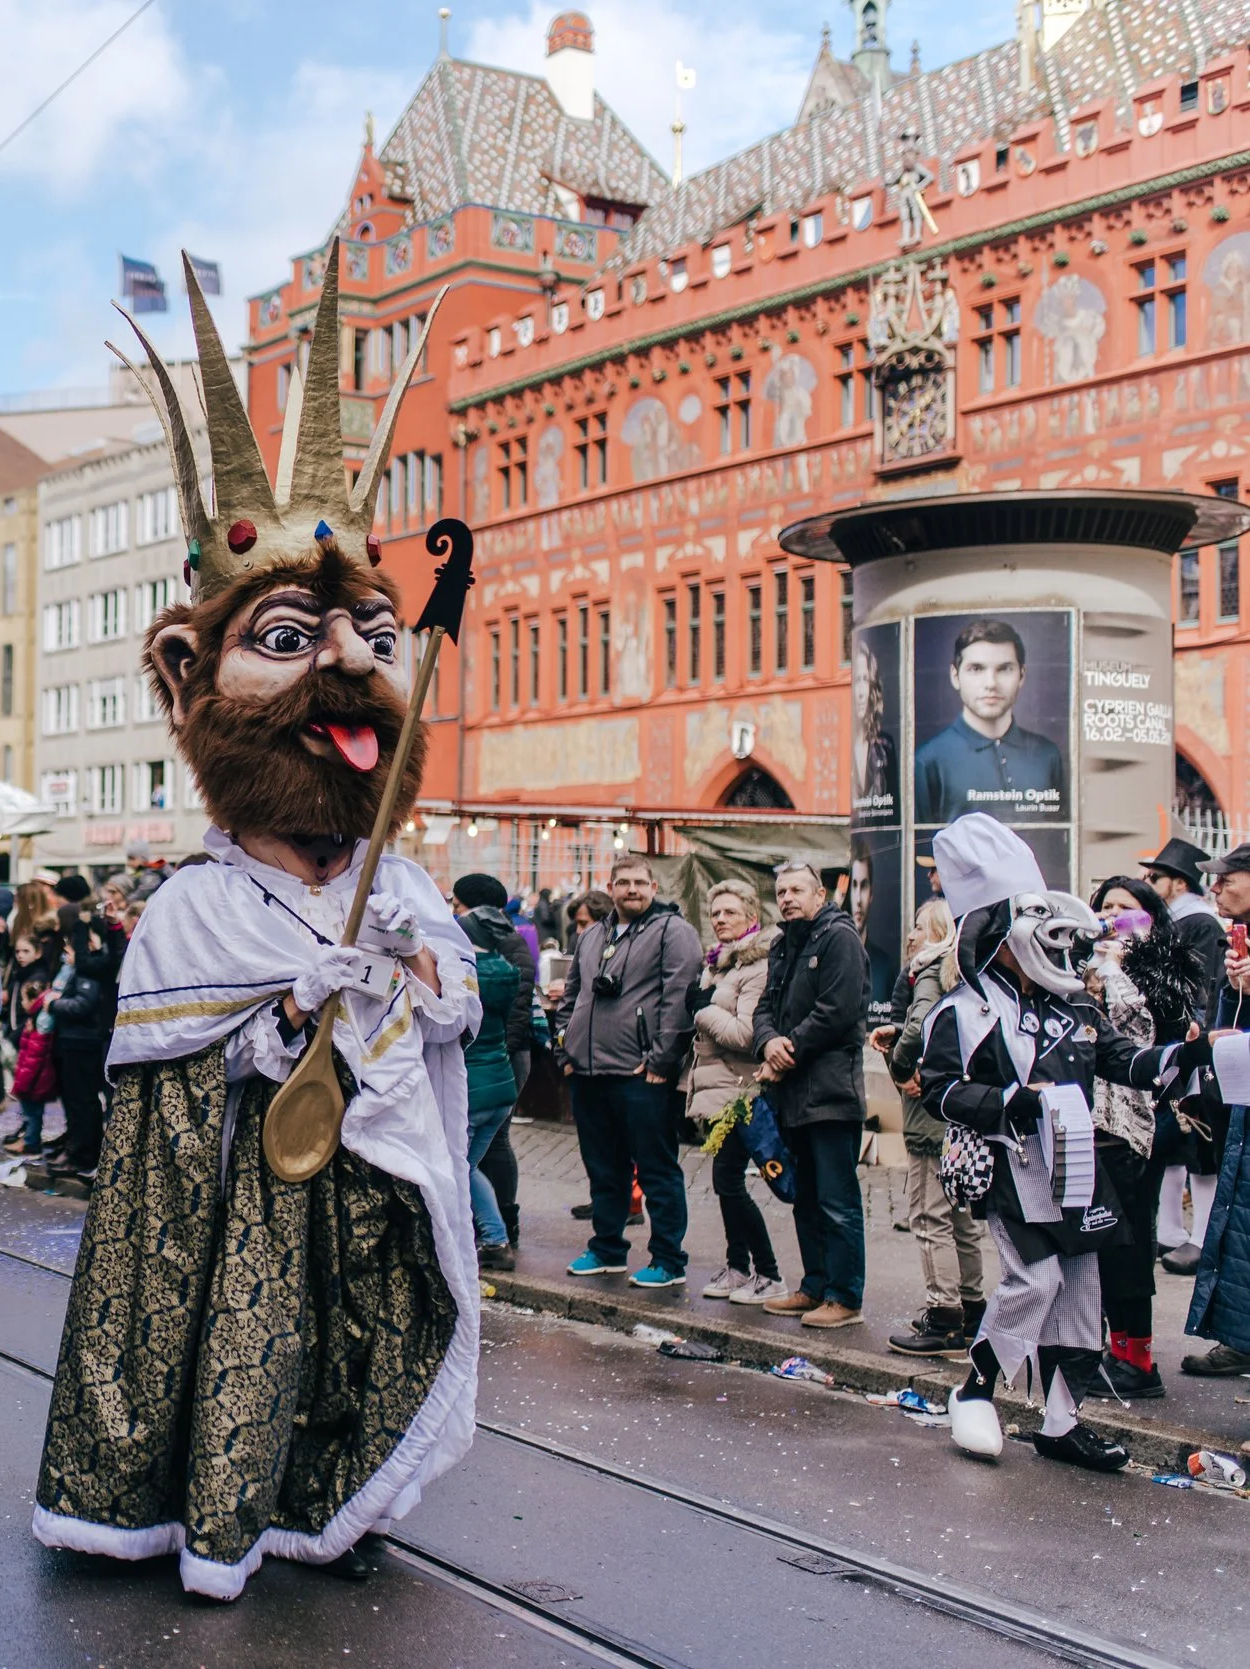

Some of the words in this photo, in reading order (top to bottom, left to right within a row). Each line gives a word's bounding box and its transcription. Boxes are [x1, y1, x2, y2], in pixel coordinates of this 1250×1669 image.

[1084, 661, 1131, 673] MUSEUM
[1084, 671, 1151, 689] TINGUELY
[1084, 699, 1145, 715] CYPRIEN
[1084, 713, 1135, 729] ROOTS
[1136, 715, 1166, 731] CANAL
[967, 789, 1023, 801] Ramstein
[1024, 789, 1060, 804] Optik
[360, 965, 373, 984] 1
